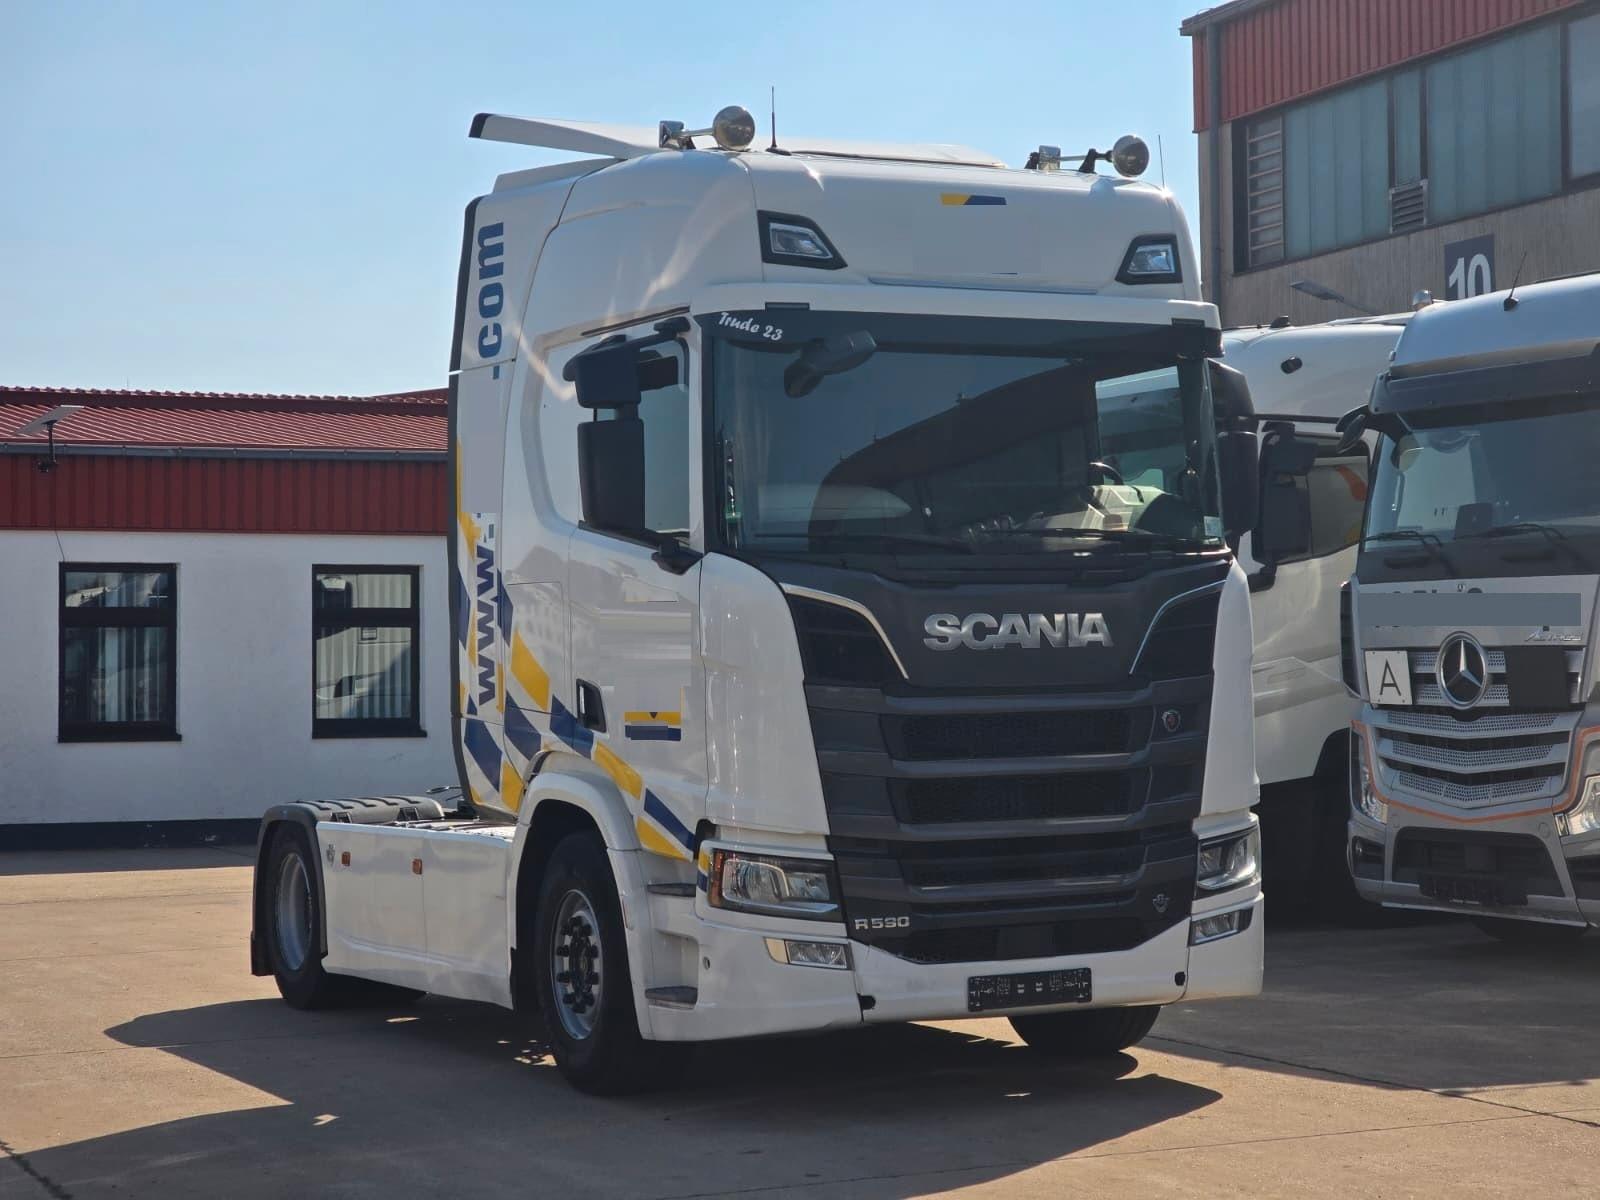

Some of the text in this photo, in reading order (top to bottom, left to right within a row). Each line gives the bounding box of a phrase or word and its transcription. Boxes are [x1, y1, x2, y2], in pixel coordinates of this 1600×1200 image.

[1449, 253, 1492, 300] 10
[719, 311, 783, 341] Trude 23
[922, 612, 1114, 652] SCANIA
[1379, 658, 1402, 697] A
